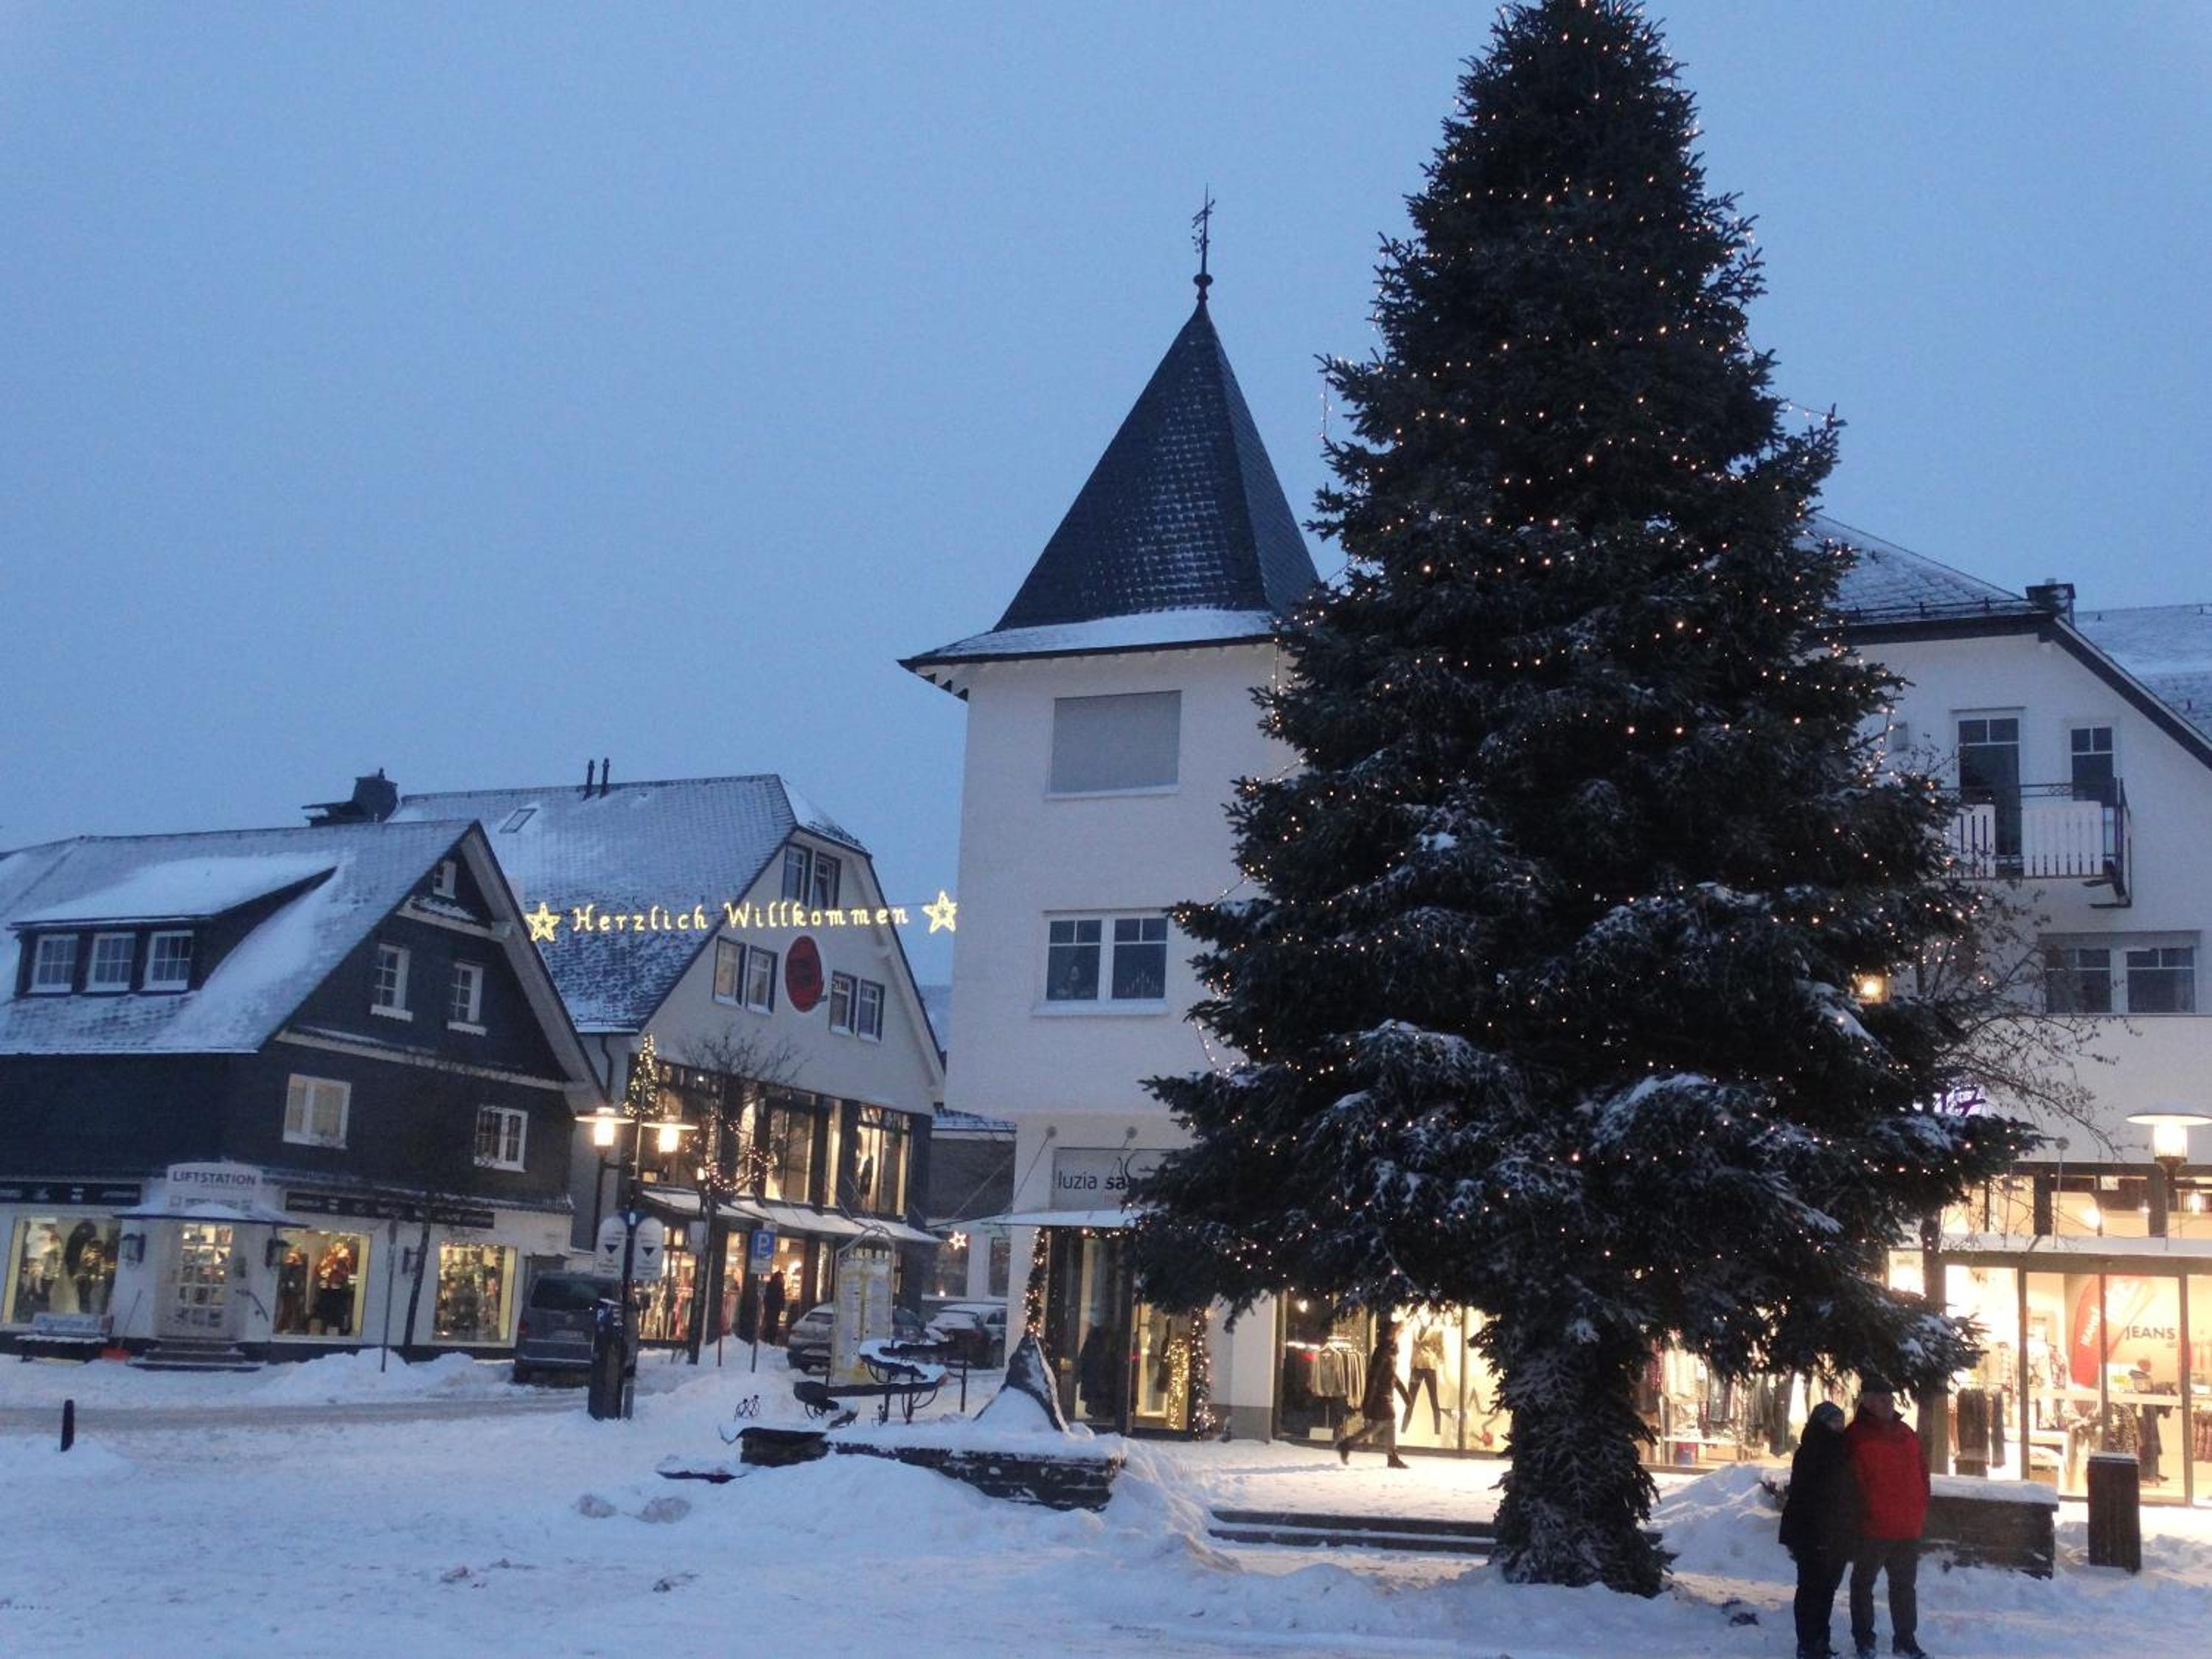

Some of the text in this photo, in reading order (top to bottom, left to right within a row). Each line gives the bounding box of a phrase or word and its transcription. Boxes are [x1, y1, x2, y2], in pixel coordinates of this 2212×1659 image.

[572, 901, 909, 932] Herzlich Willkommen
[172, 1170, 257, 1186] LIFTSTATION
[1058, 1170, 1098, 1189] luzia
[757, 1234, 771, 1255] P
[2124, 1325, 2176, 1340] JEANS
